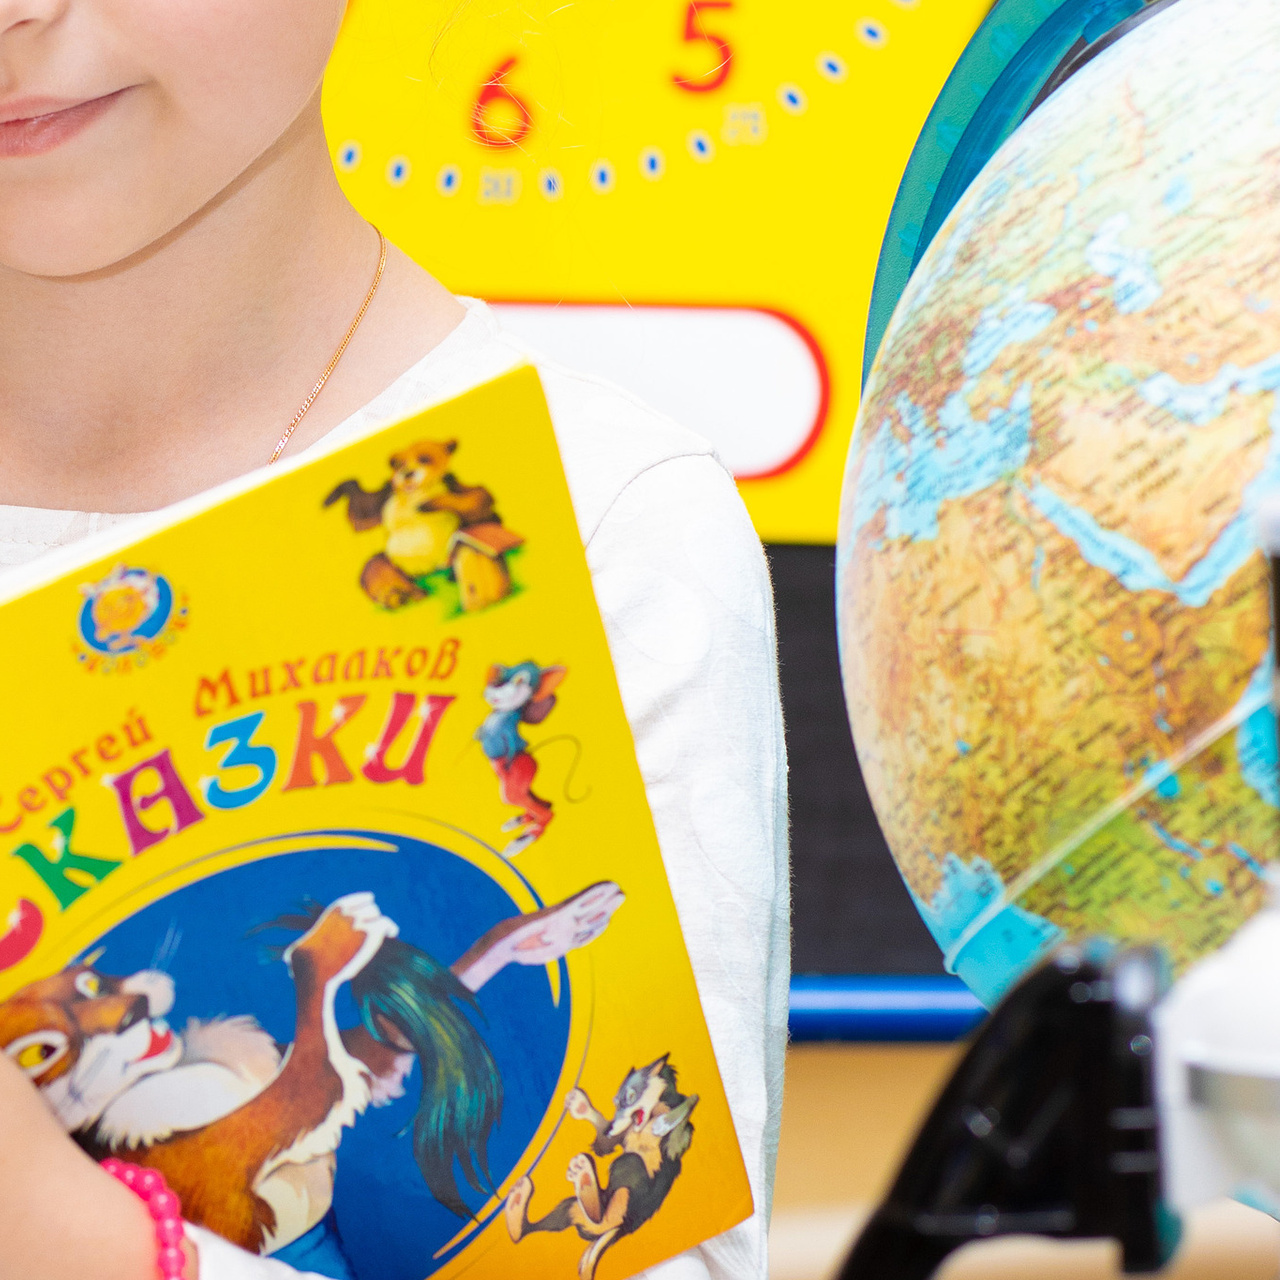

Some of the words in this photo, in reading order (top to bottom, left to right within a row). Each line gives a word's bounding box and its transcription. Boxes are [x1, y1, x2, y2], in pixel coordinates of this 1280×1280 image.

[671, 0, 735, 94] 5
[471, 55, 533, 148] 6
[193, 637, 462, 719] Михалков
